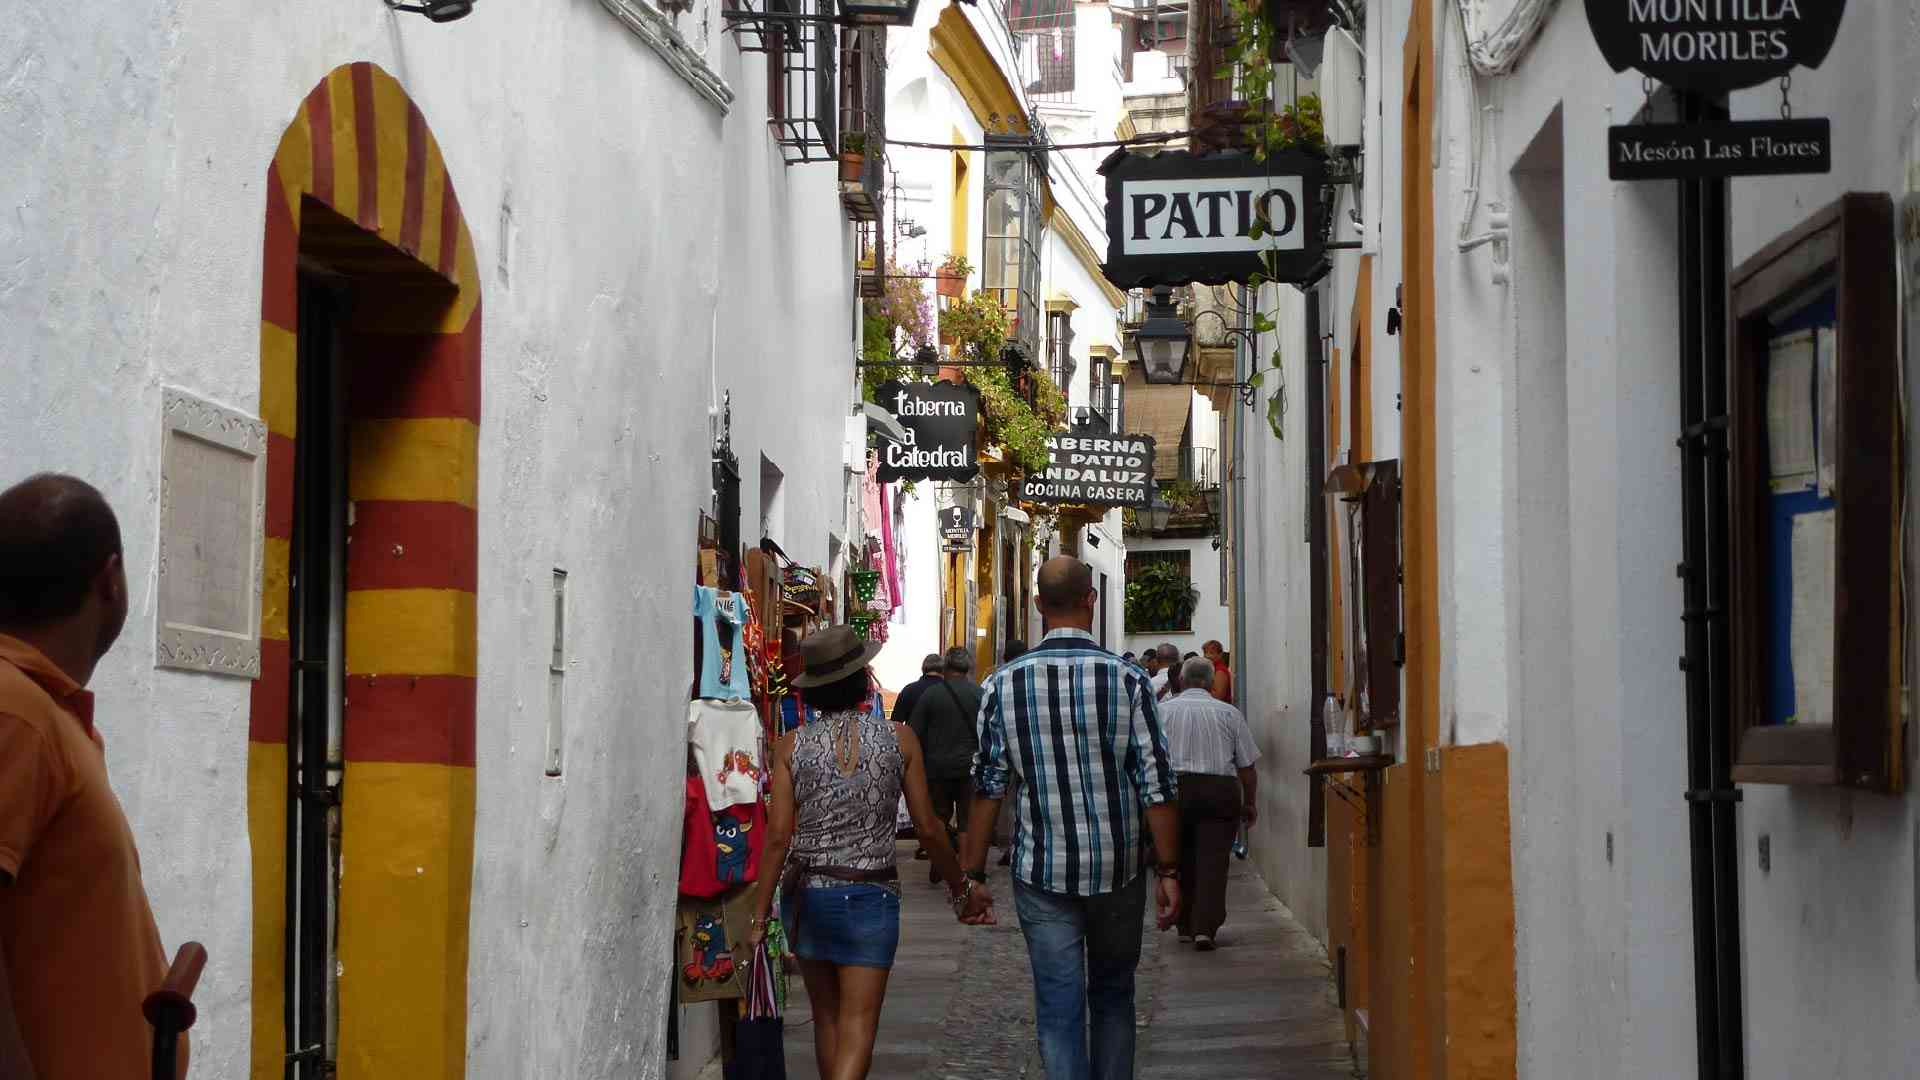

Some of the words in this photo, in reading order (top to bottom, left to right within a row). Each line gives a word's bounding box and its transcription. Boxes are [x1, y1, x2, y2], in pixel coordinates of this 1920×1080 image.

[1627, 0, 1801, 23] MONTILLA
[1640, 29, 1789, 62] MORILES
[1619, 141, 1695, 163] Mesón
[1704, 138, 1742, 159] Las
[1750, 135, 1821, 157] Flores
[1130, 188, 1297, 241] PATIO
[886, 440, 969, 468] Catedral
[1045, 437, 1146, 453] ABERNA
[1071, 454, 1142, 467] PATIO
[1025, 482, 1081, 498] COCINA
[1086, 486, 1145, 501] CASERA
